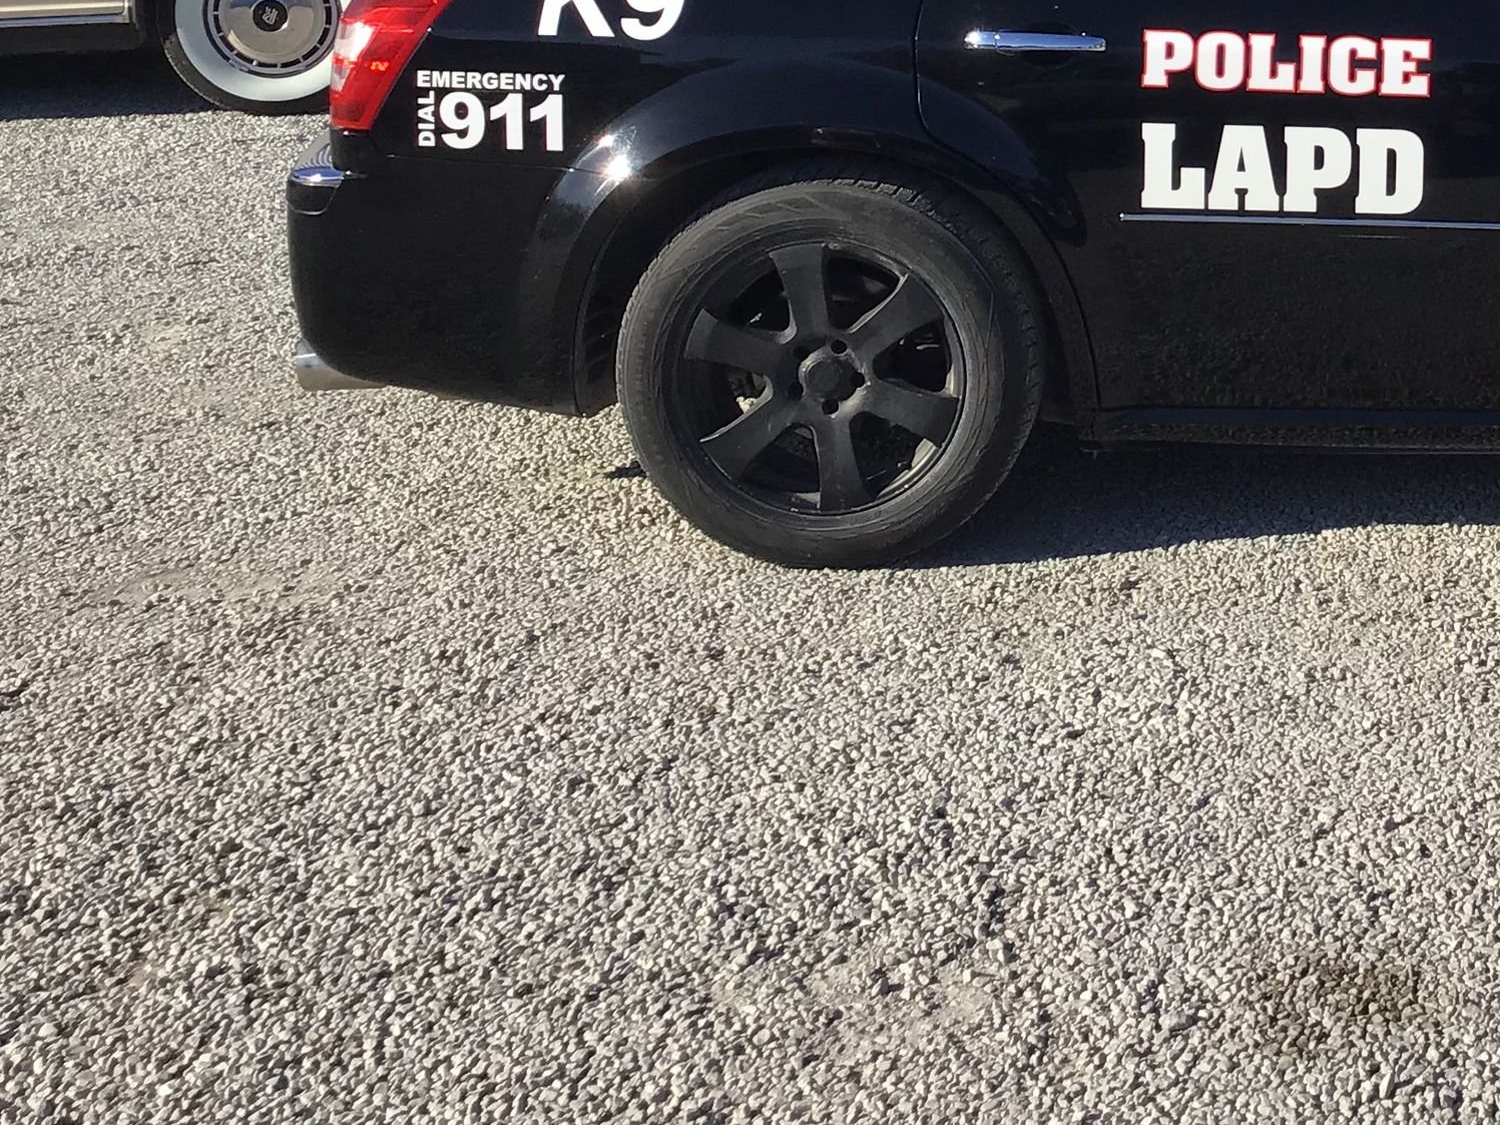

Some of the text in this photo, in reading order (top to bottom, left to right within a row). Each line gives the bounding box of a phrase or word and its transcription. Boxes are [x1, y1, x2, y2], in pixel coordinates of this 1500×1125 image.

[416, 69, 566, 92] EMERGENCY
[1140, 28, 1433, 98] POLICE
[417, 90, 436, 148] DIAL
[438, 91, 565, 152] 911
[1140, 122, 1425, 215] LAPD
